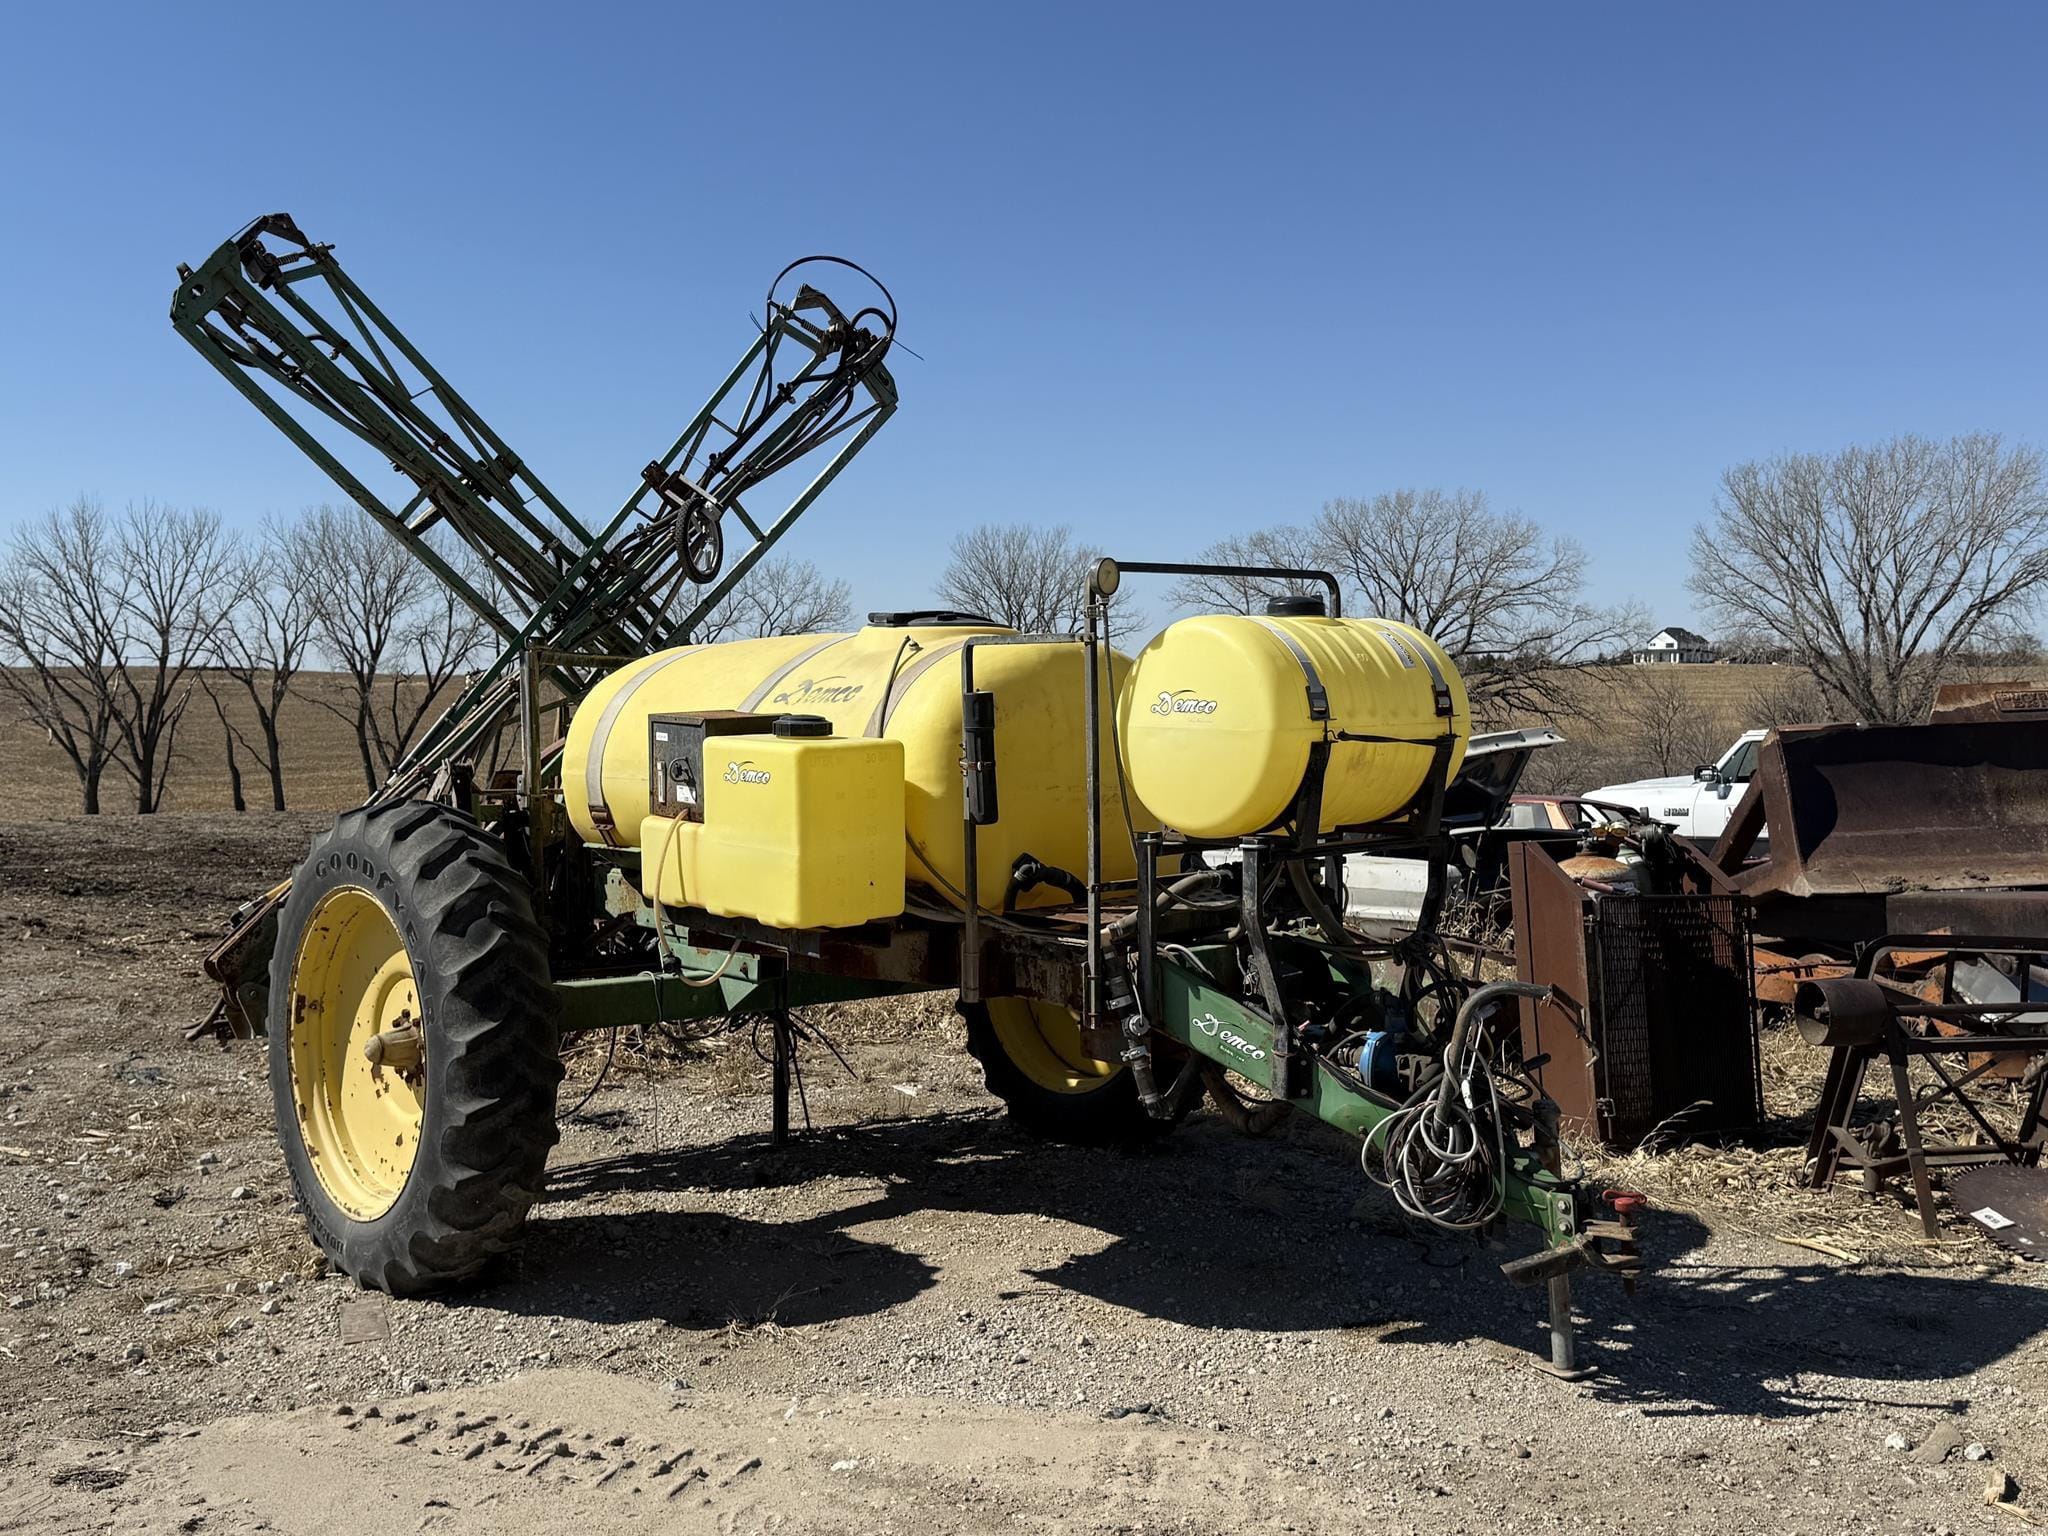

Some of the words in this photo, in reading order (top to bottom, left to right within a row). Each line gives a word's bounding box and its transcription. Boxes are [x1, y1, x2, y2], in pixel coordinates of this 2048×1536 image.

[773, 676, 864, 705] Demco
[1150, 689, 1218, 716] Demco
[723, 761, 771, 784] Demco
[315, 851, 435, 1026] GOODYEAR
[1192, 1012, 1266, 1060] Demco
